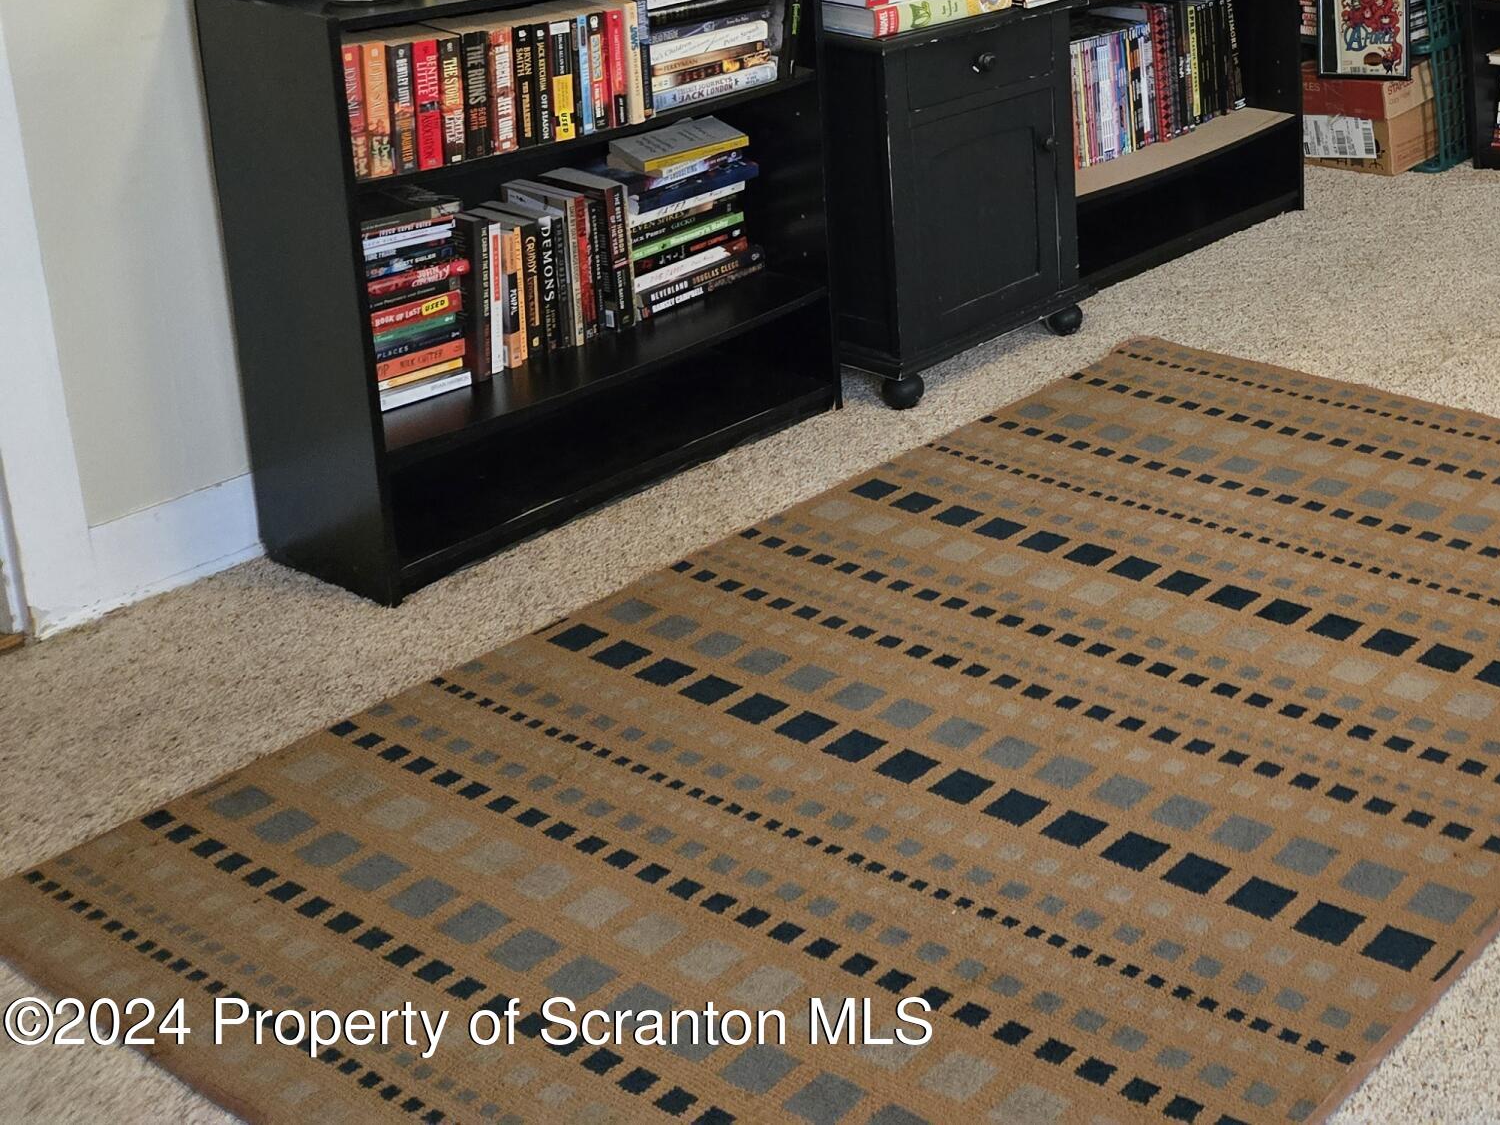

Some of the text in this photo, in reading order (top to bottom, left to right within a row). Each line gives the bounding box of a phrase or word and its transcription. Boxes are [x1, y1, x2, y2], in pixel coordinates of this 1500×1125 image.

[879, 10, 888, 36] MARVEL
[1344, 25, 1395, 52] A-FORCE
[396, 58, 409, 84] BENTLEY
[516, 48, 525, 76] SMITH
[523, 47, 533, 75] BRYAN
[416, 62, 430, 96] LITTLE
[426, 55, 438, 99] BENTLEY
[466, 45, 487, 106] THE RUINS
[678, 82, 734, 103] JACK LONDON
[499, 116, 514, 139] LONG
[541, 111, 550, 140] SEASON
[560, 112, 569, 133] USED
[525, 236, 538, 274] CRUDDY
[541, 226, 555, 302] DEMONS
[425, 299, 446, 312] USED
[510, 288, 518, 316] PENPAL
[650, 282, 688, 302] NEVERLAND
[375, 314, 395, 327] BOOK
[377, 345, 410, 359] PLACES
